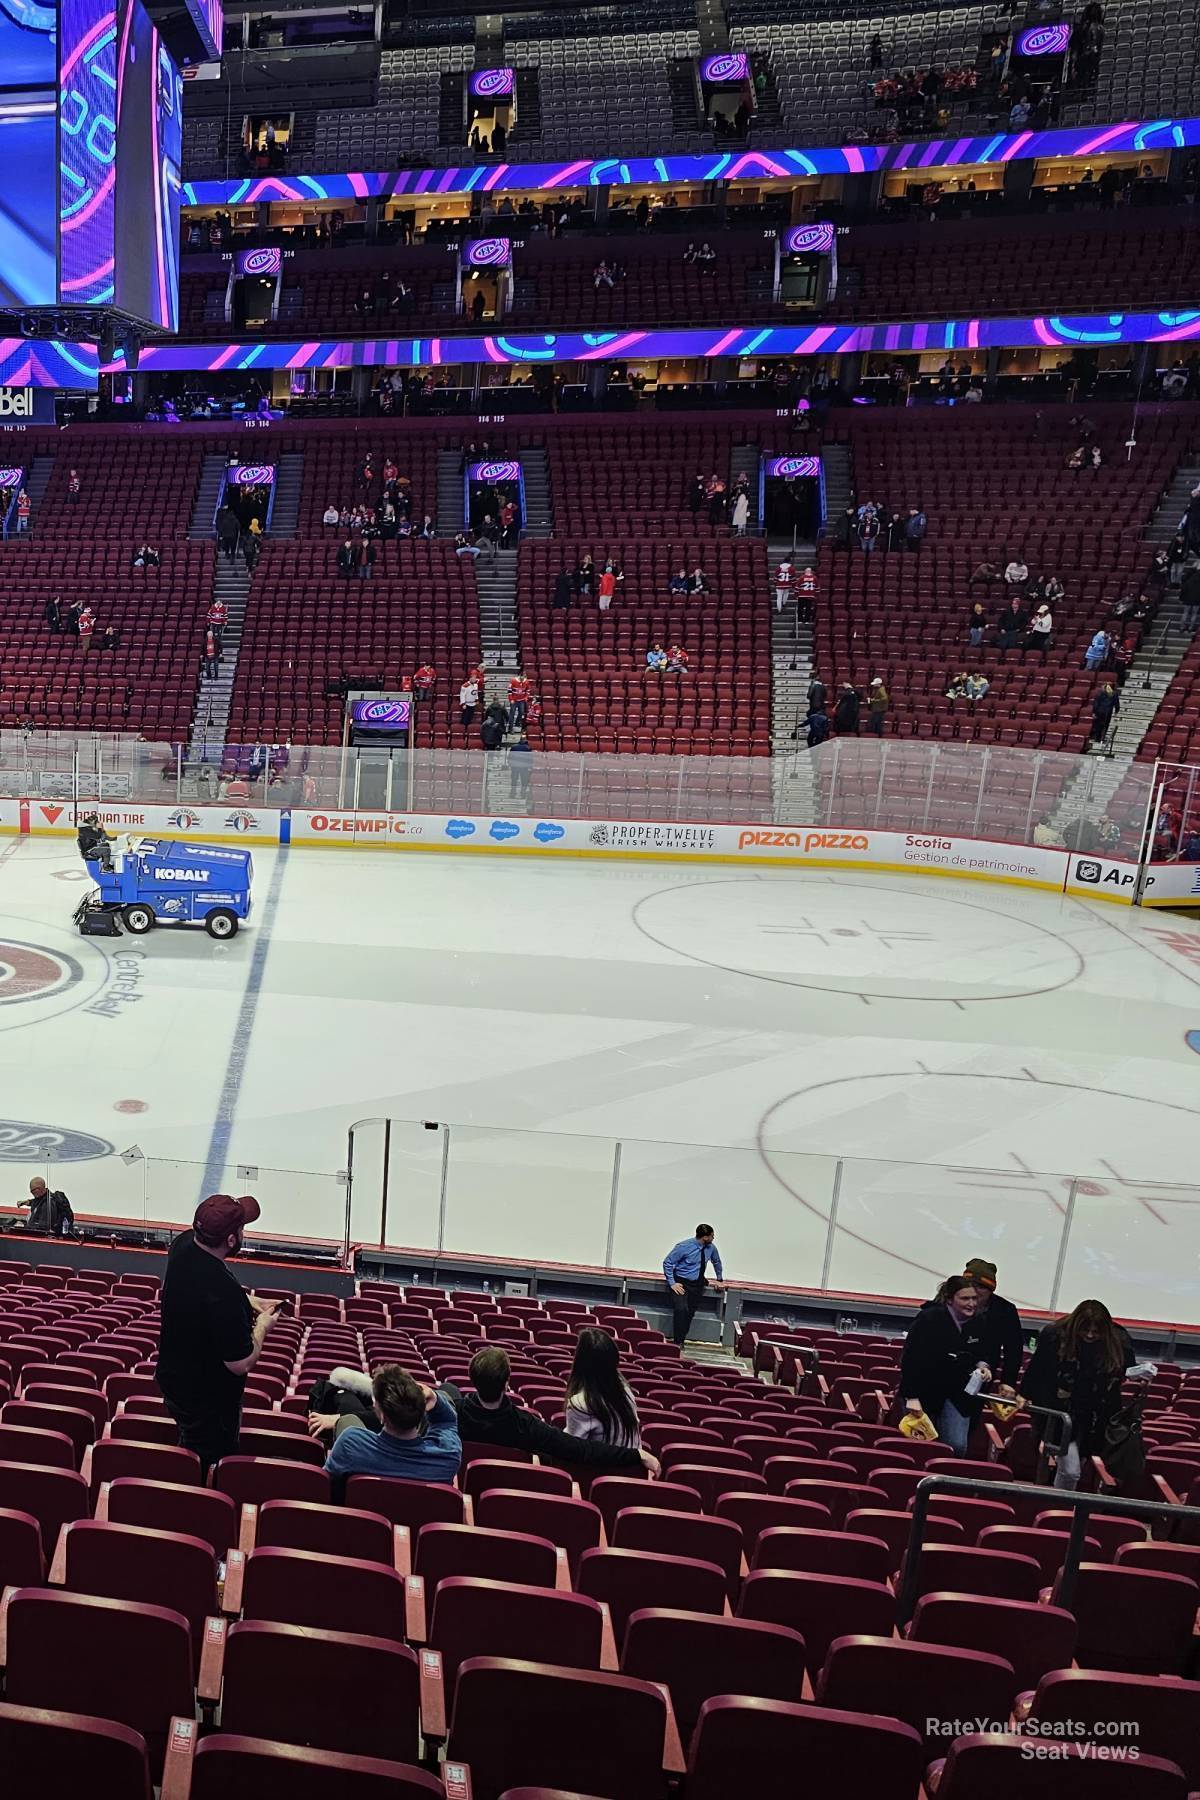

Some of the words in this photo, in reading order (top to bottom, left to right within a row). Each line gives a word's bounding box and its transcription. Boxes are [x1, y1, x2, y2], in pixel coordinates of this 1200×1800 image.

[837, 226, 850, 234] 216
[446, 243, 458, 251] 214
[121, 813, 145, 825] TIRE
[612, 825, 661, 839] PROPER
[666, 828, 715, 841] TWELVE
[611, 839, 648, 847] IRISH
[655, 841, 715, 849] WHISKEY
[738, 830, 800, 850] pizza
[803, 831, 869, 852] pizza
[905, 834, 952, 850] Scotia
[903, 850, 949, 864] Gestion
[951, 855, 967, 866] de
[155, 867, 209, 882] KOBALT
[82, 950, 147, 1019] CentreBell
